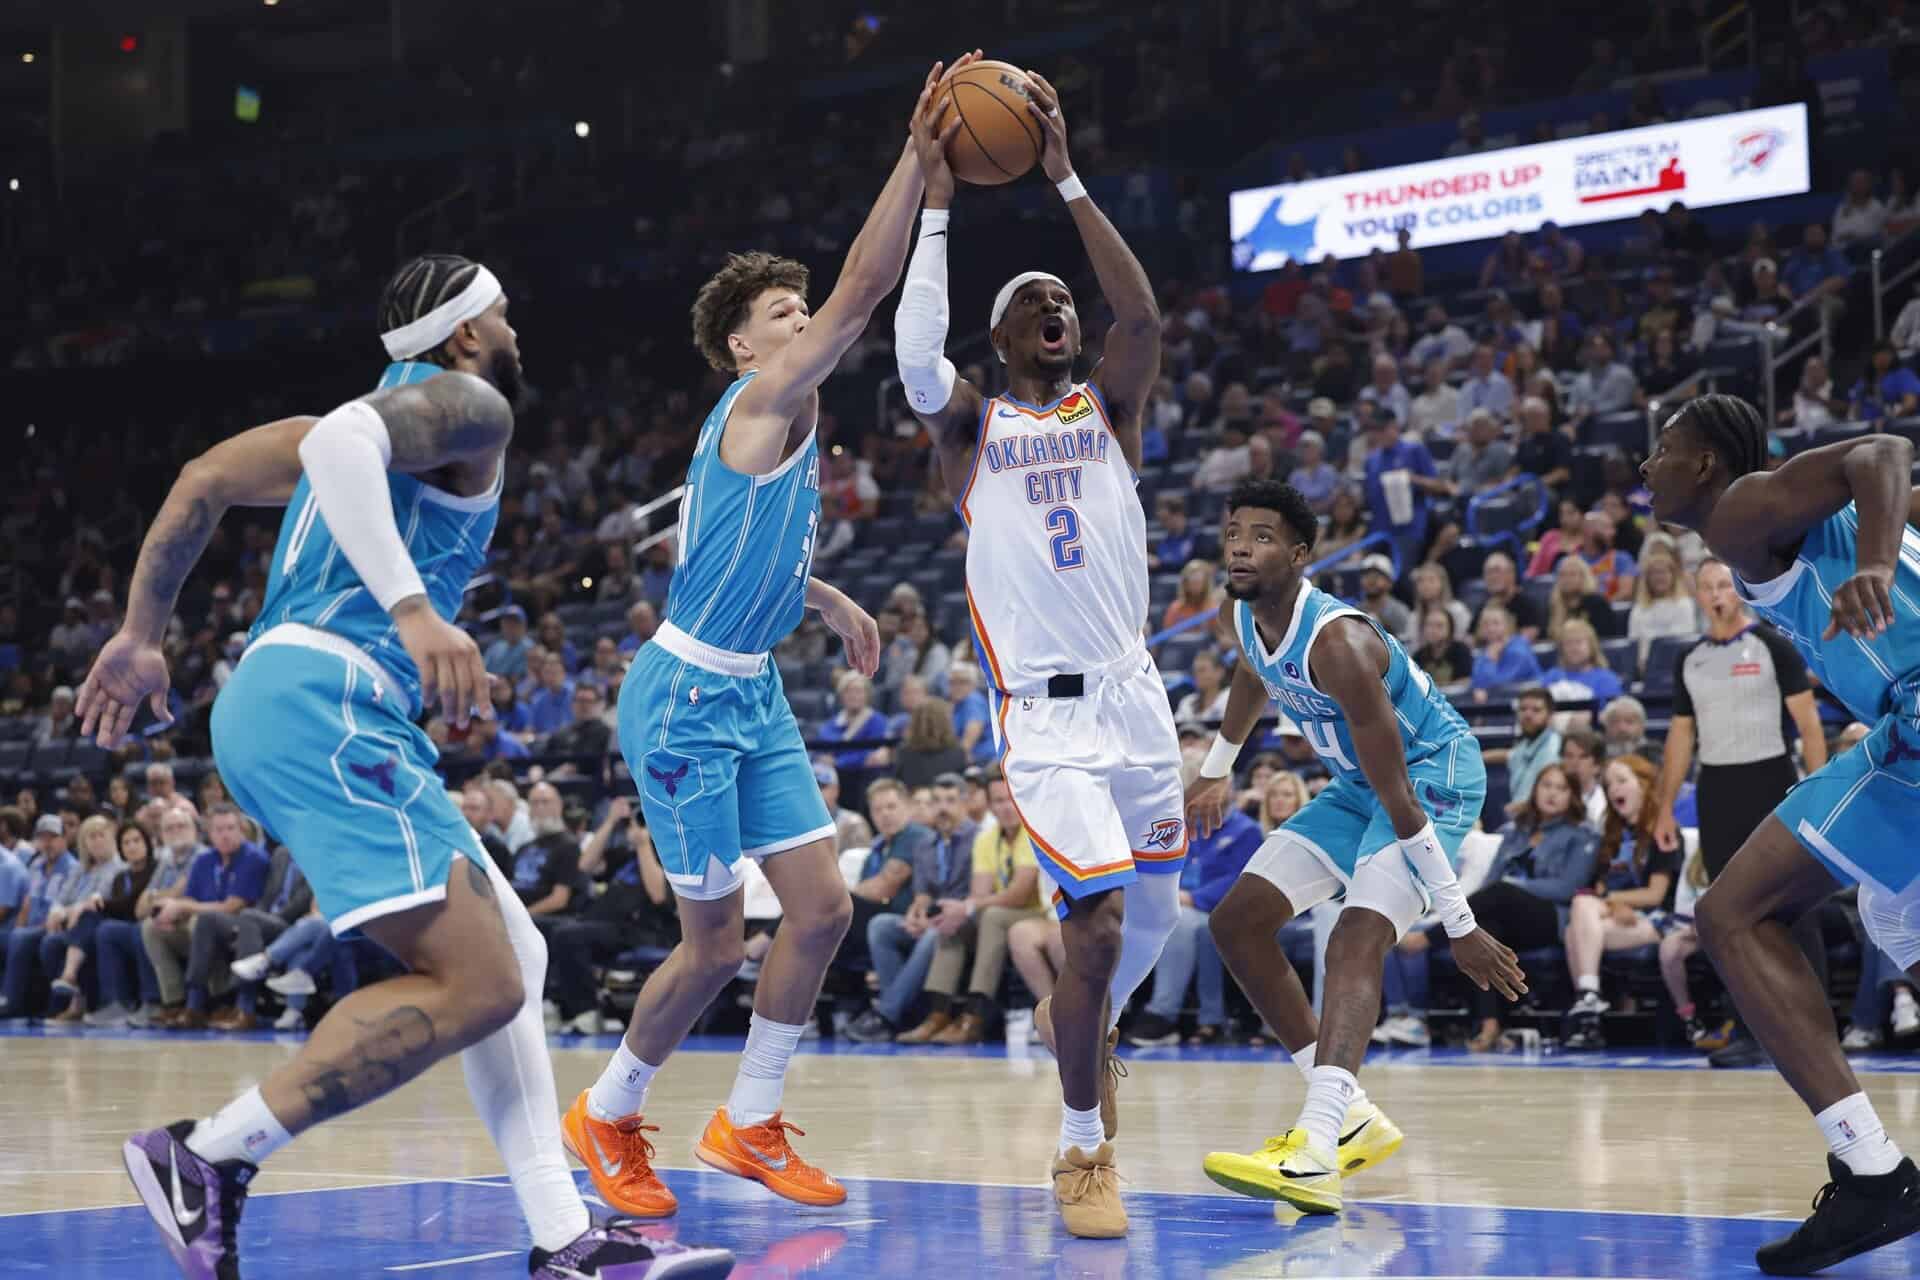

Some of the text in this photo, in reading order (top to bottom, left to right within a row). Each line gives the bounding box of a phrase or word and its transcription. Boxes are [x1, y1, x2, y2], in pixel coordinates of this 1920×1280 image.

[1344, 163, 1542, 212] THUNDER UP
[1575, 160, 1659, 191] PAINT
[1344, 192, 1543, 238] YOUR COLORS
[985, 429, 1109, 473] OKLAHOMA
[1025, 466, 1082, 504] CITY
[1045, 506, 1086, 572] 2
